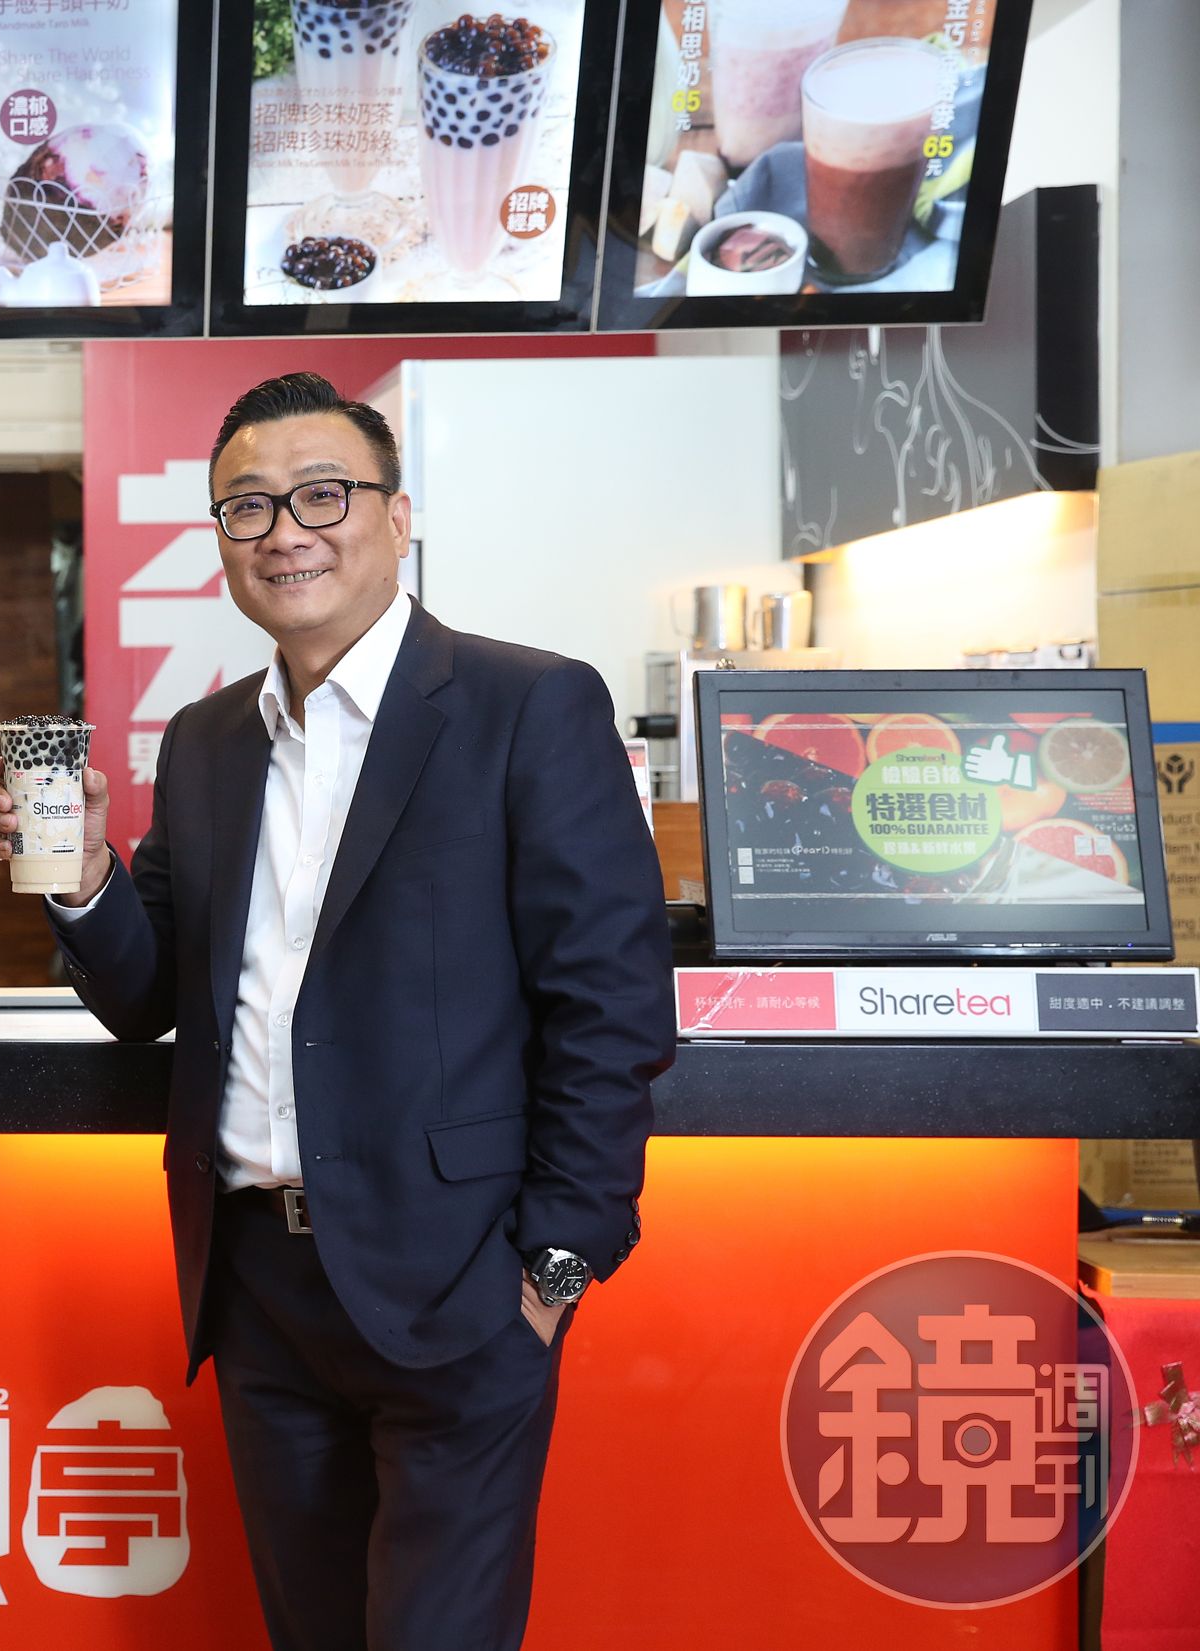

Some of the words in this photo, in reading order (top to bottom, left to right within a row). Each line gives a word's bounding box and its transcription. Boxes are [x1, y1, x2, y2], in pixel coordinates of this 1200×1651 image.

[676, 0, 706, 87] 相思奶
[0, 50, 43, 66] Share
[49, 49, 79, 63] The
[83, 48, 130, 63] World
[16, 67, 63, 83] Share
[9, 96, 48, 116] 濃郁
[672, 91, 701, 112] 65
[254, 103, 393, 126] 招牌珍珠奶茶
[675, 114, 691, 131] 元
[9, 117, 48, 136] 口感
[253, 130, 393, 153] 招牌珍珠奶綠
[922, 135, 954, 158] 65
[925, 159, 943, 177] 元
[509, 192, 548, 212] 招牌
[866, 793, 987, 821] 特選食材
[869, 823, 906, 835] 100%
[908, 823, 989, 835] GUARANTEE
[926, 933, 957, 942] ASUS
[859, 986, 1011, 1016] Sharetea
